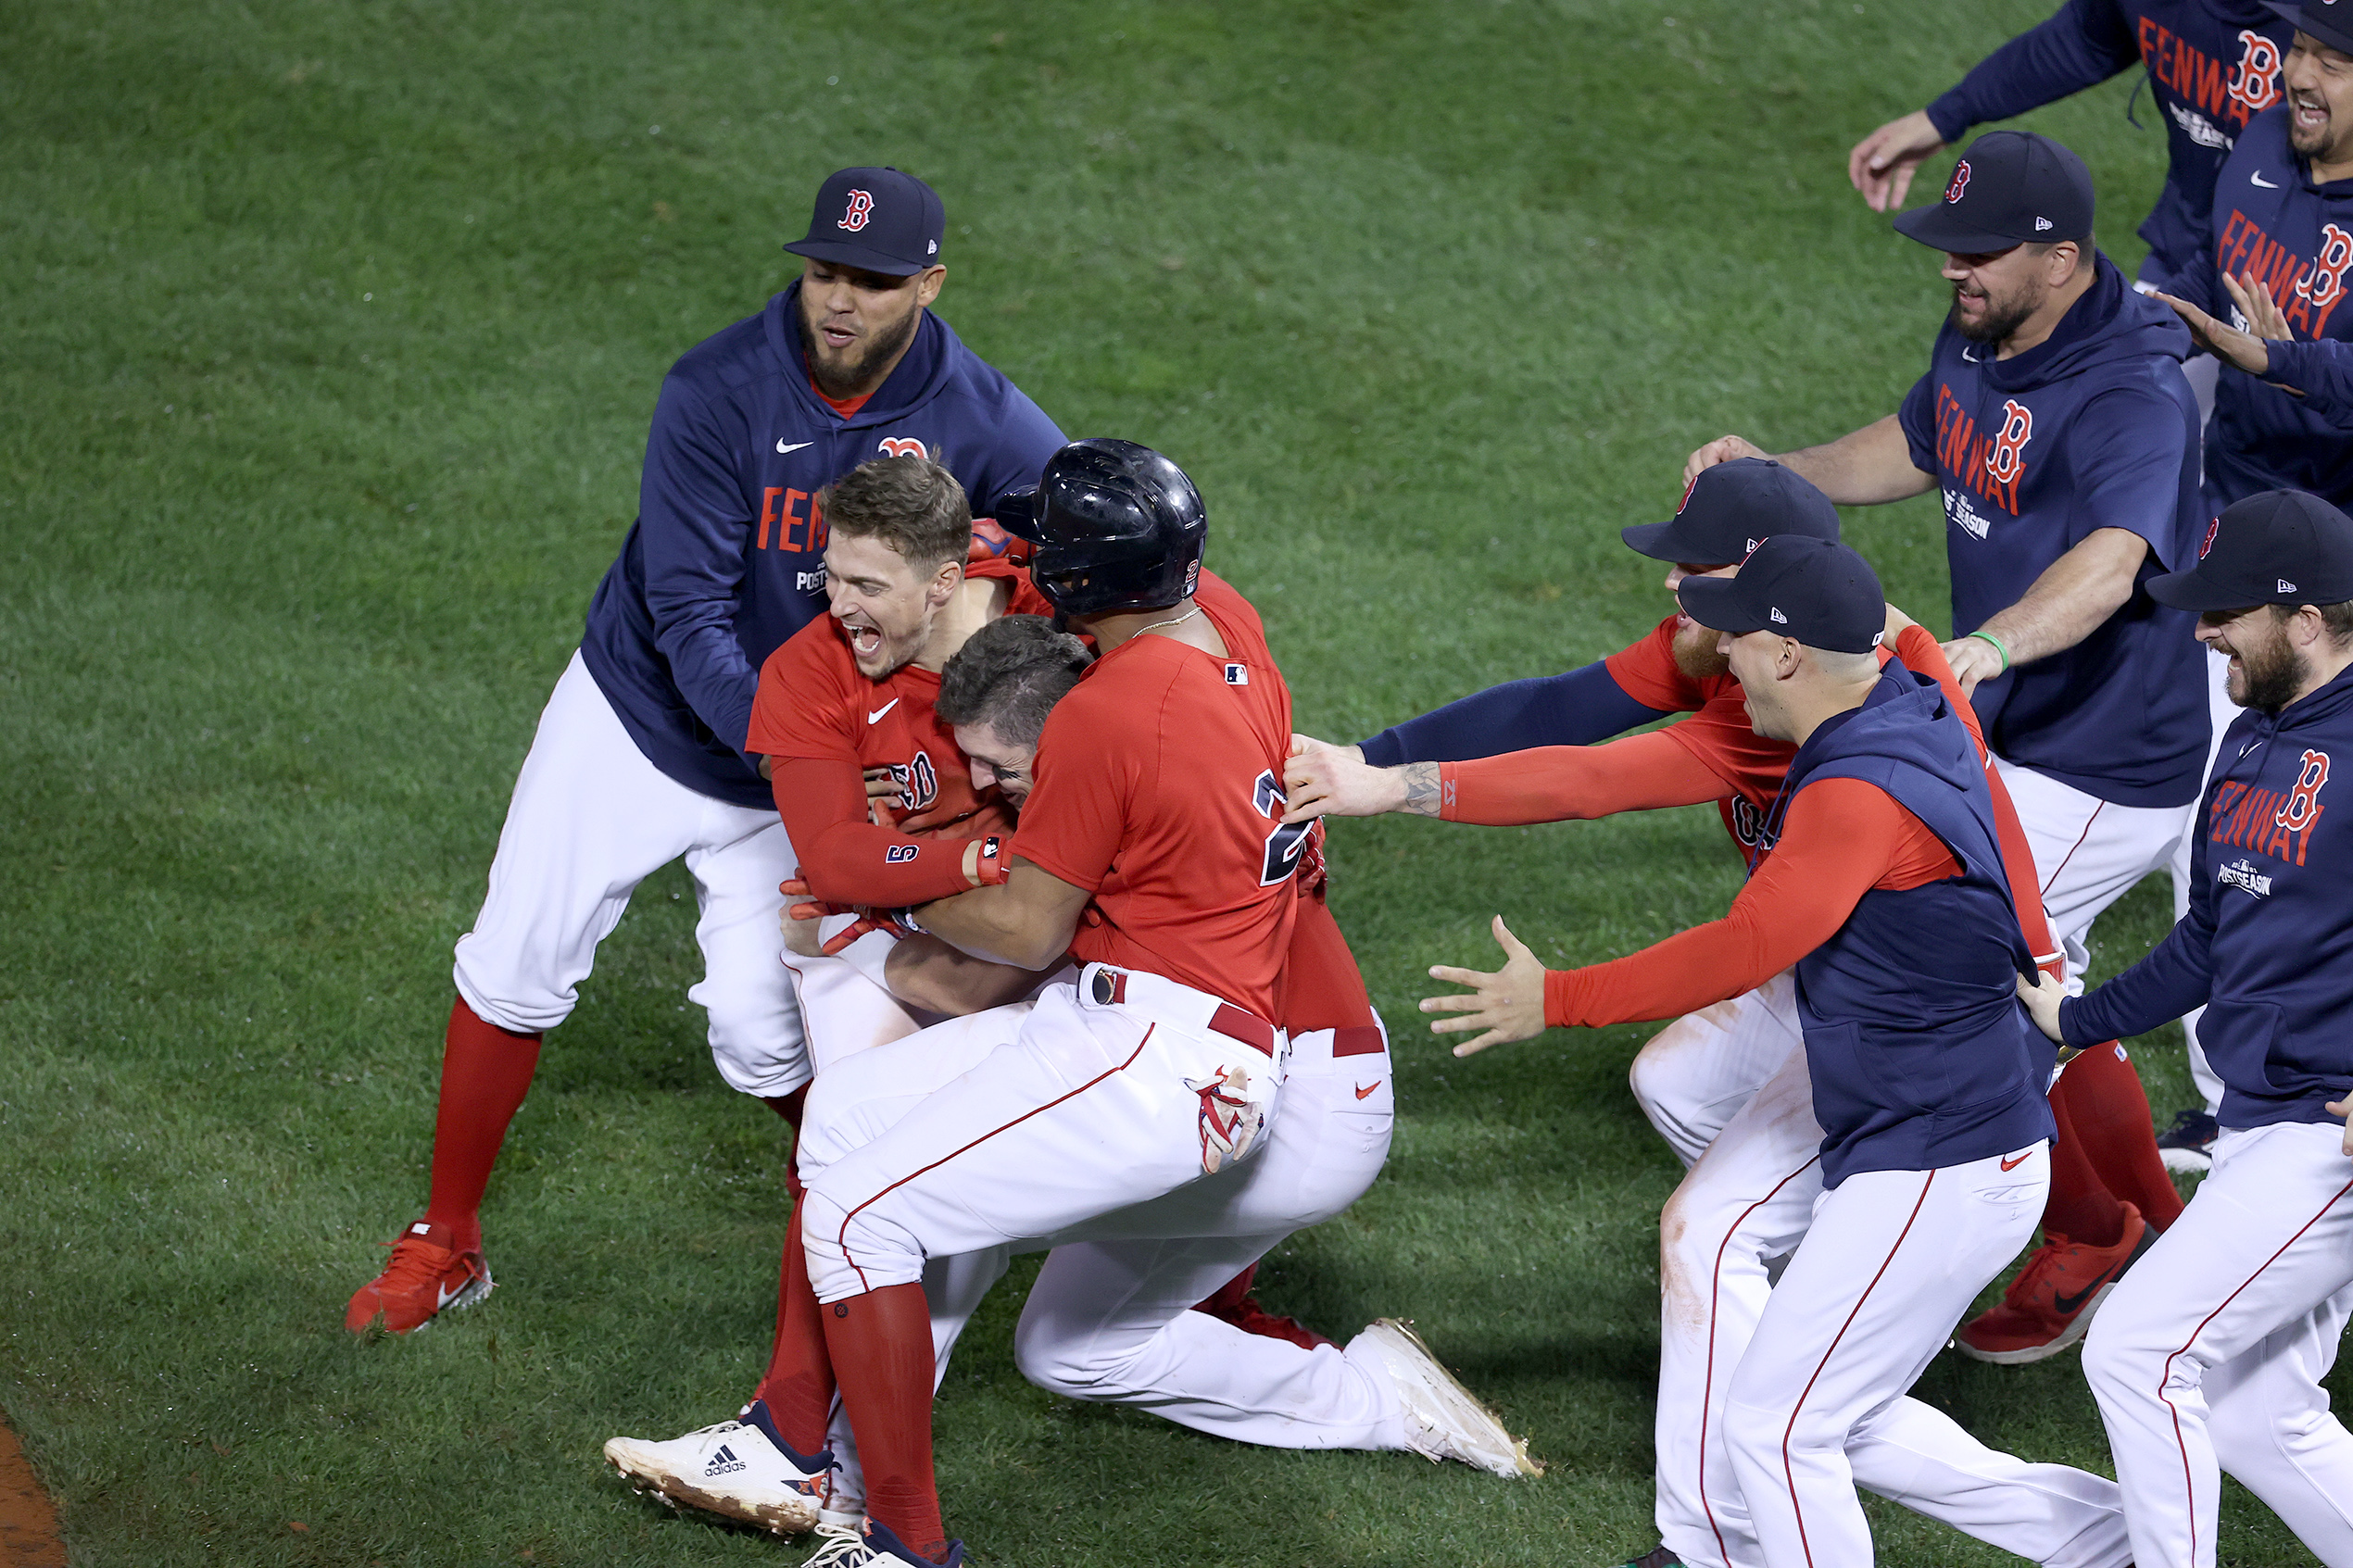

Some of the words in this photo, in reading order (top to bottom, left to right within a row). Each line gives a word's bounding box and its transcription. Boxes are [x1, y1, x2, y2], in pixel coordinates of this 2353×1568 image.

[2228, 30, 2283, 109] B
[837, 189, 875, 232] B
[1945, 159, 1971, 204] B
[2216, 208, 2349, 341] FENWAY
[2296, 223, 2353, 307] B
[1985, 398, 2033, 483] B
[1186, 558, 1199, 583] 2
[1252, 768, 1322, 887] 2
[2208, 780, 2325, 867] FENWAY
[2275, 748, 2331, 832] B
[886, 844, 920, 863] 5
[2217, 863, 2272, 896] POSTSEASON
[705, 1461, 747, 1477] adidas
